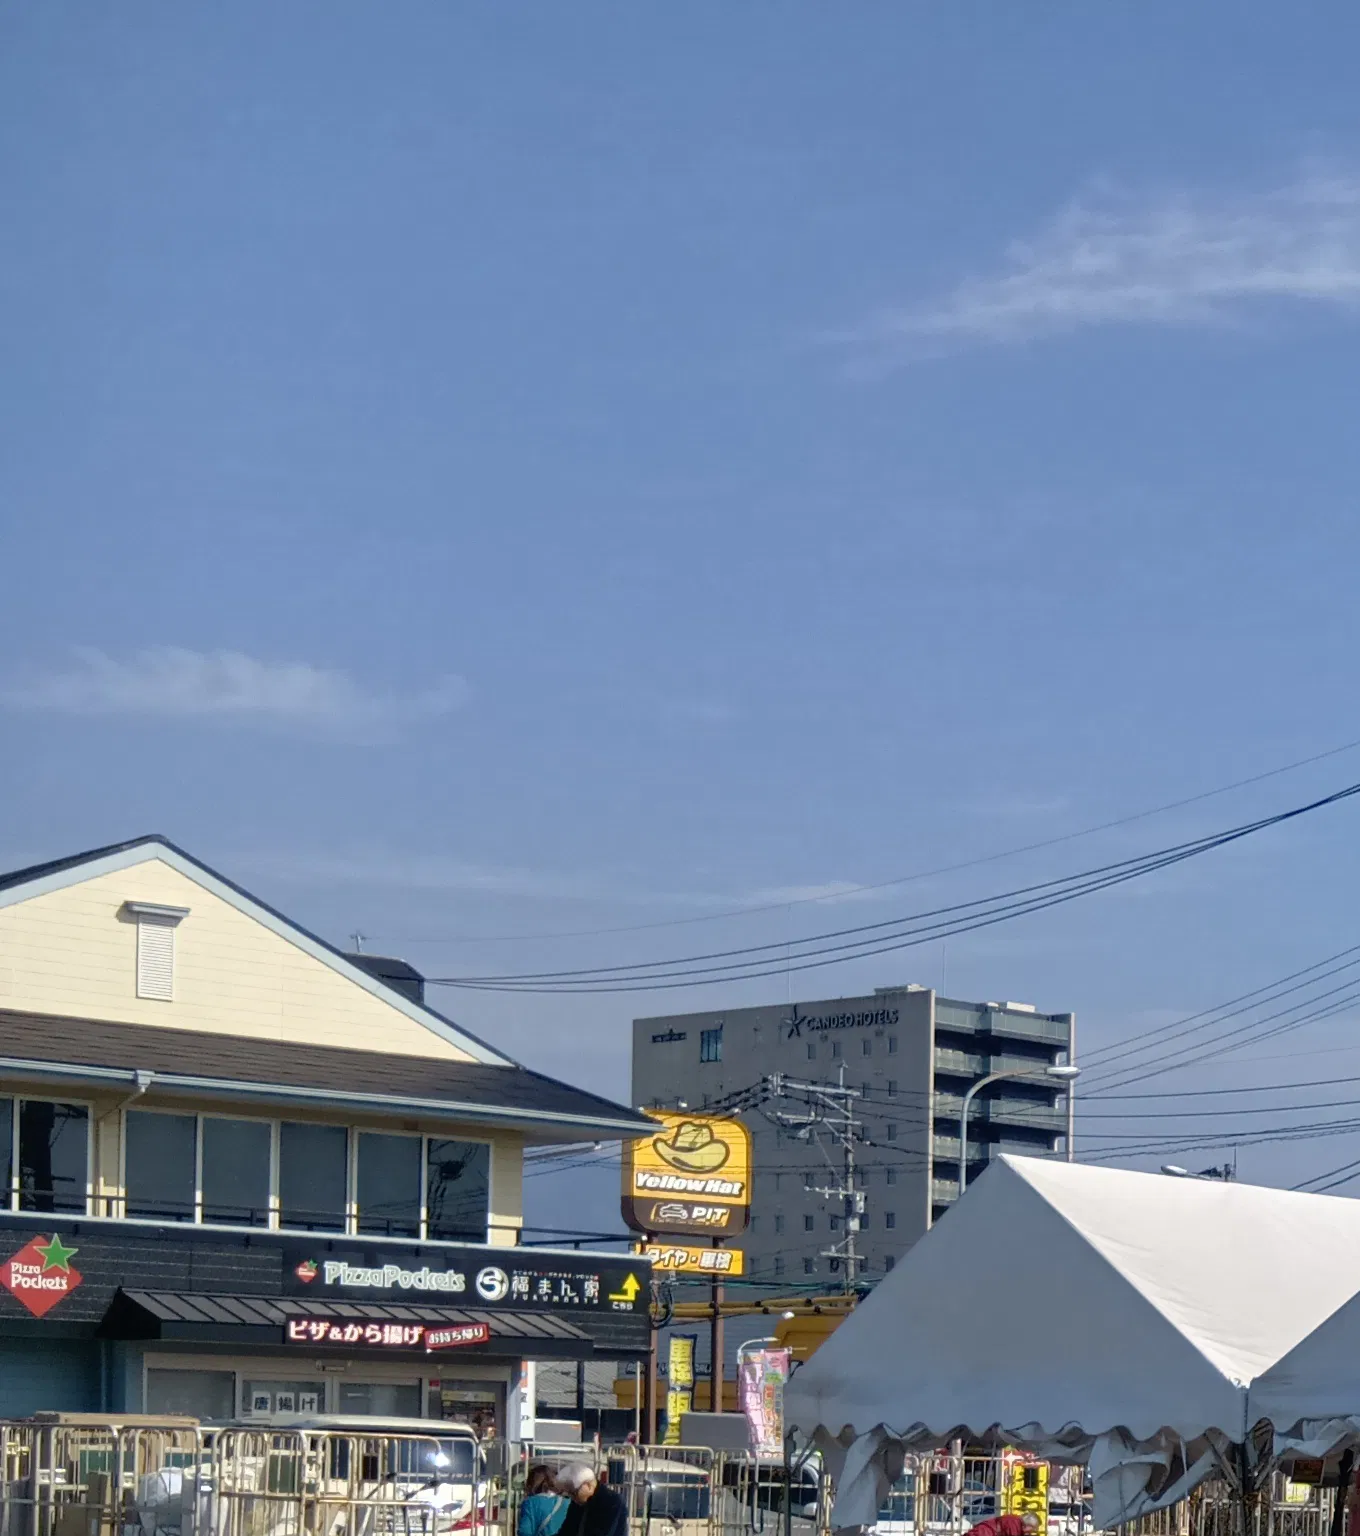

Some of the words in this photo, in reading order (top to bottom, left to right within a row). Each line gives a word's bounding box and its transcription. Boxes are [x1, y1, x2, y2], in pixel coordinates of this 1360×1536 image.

[807, 1013, 854, 1031] CANDEO
[856, 1008, 899, 1028] HOTELS
[692, 1206, 728, 1220] PIT
[11, 1262, 40, 1274] Pizza
[11, 1274, 68, 1290] Pockets
[512, 1275, 600, 1299] 福まん家
[428, 1327, 484, 1344] お持ち帰り
